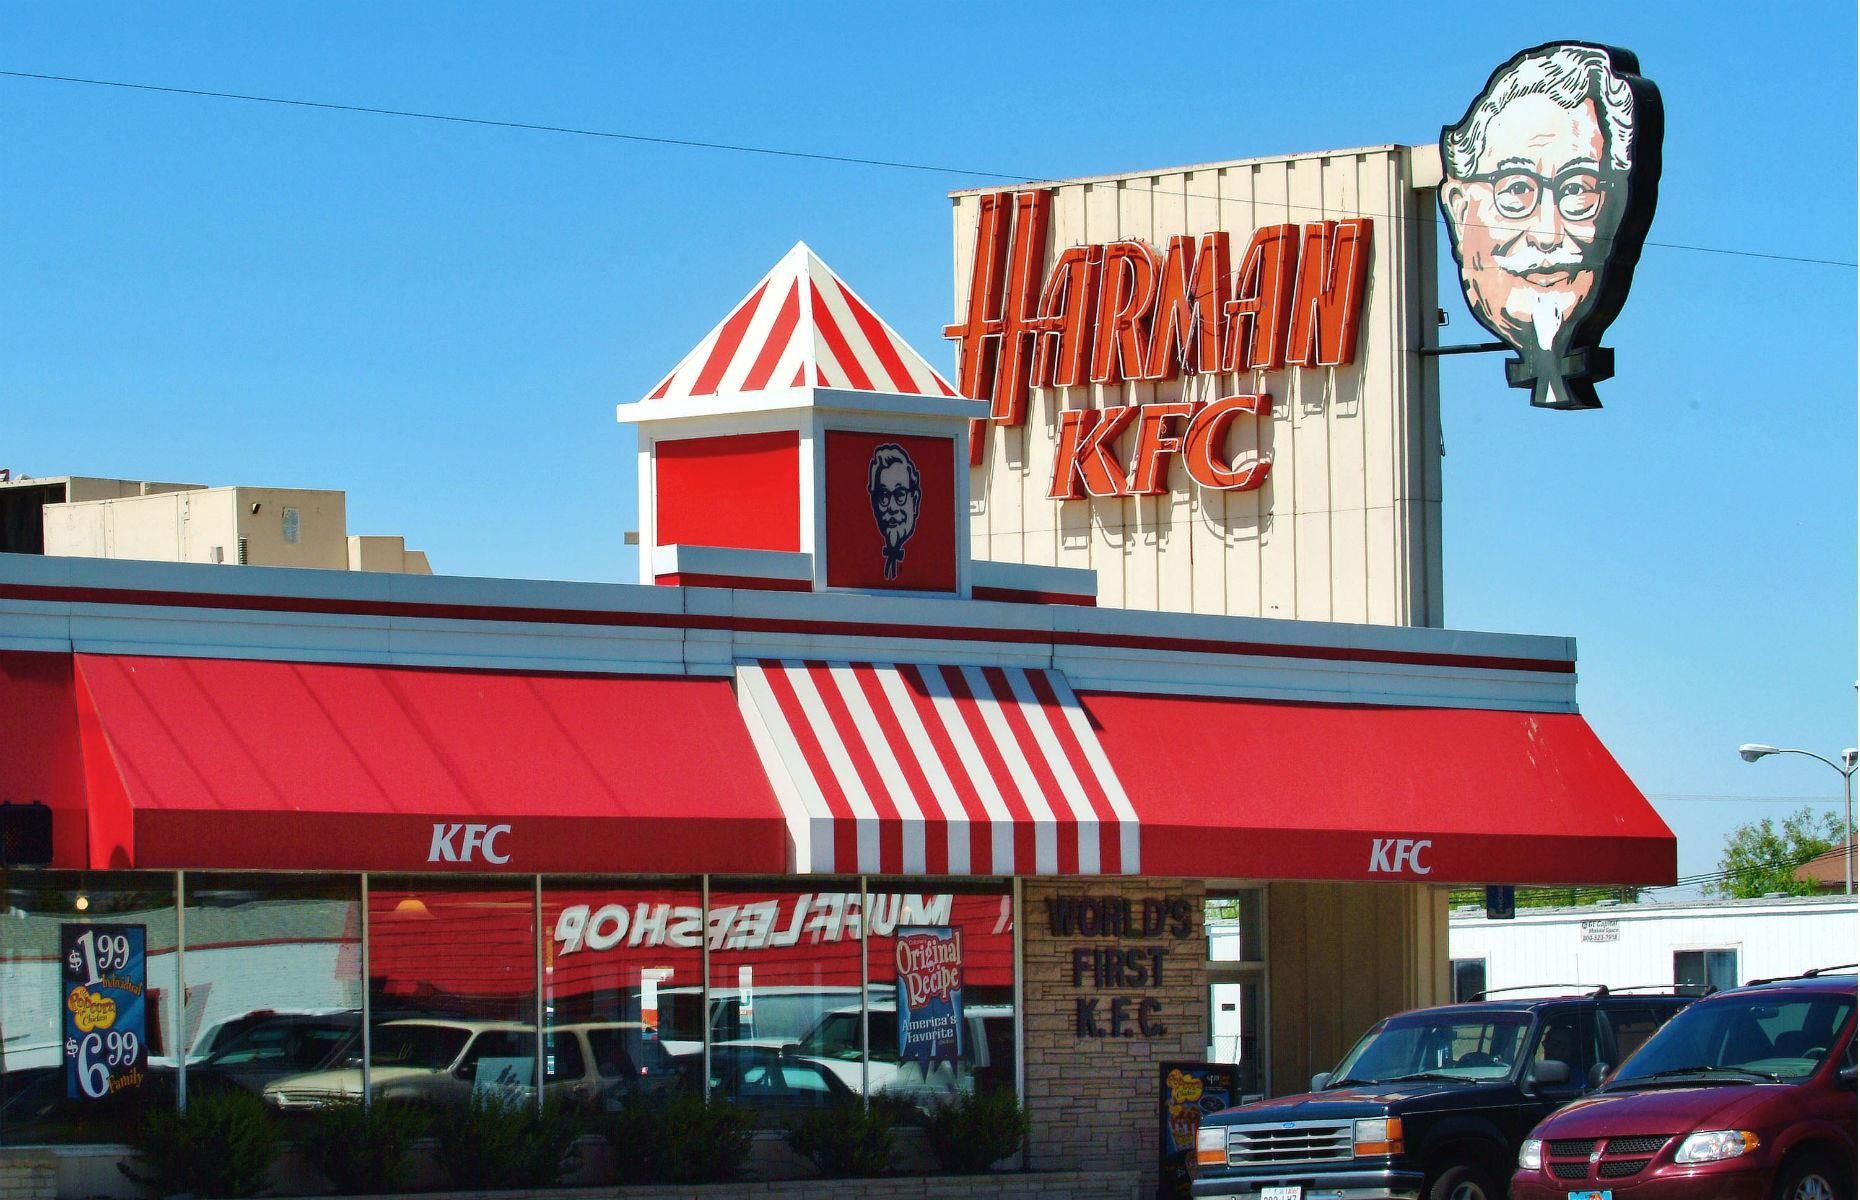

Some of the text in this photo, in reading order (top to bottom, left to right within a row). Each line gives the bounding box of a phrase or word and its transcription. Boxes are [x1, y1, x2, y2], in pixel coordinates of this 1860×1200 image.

[942, 189, 1374, 465] HARMAN
[1046, 394, 1273, 500] KFC
[427, 824, 512, 865] KFC
[1367, 838, 1432, 875] KFC
[1045, 896, 1193, 939] WORLD'S
[896, 931, 962, 975] Original
[1072, 948, 1169, 989] FIRST
[907, 964, 959, 1007] Recipe
[902, 1013, 957, 1032] America's
[1076, 997, 1168, 1038] K.F.C.
[107, 1066, 144, 1094] Family
